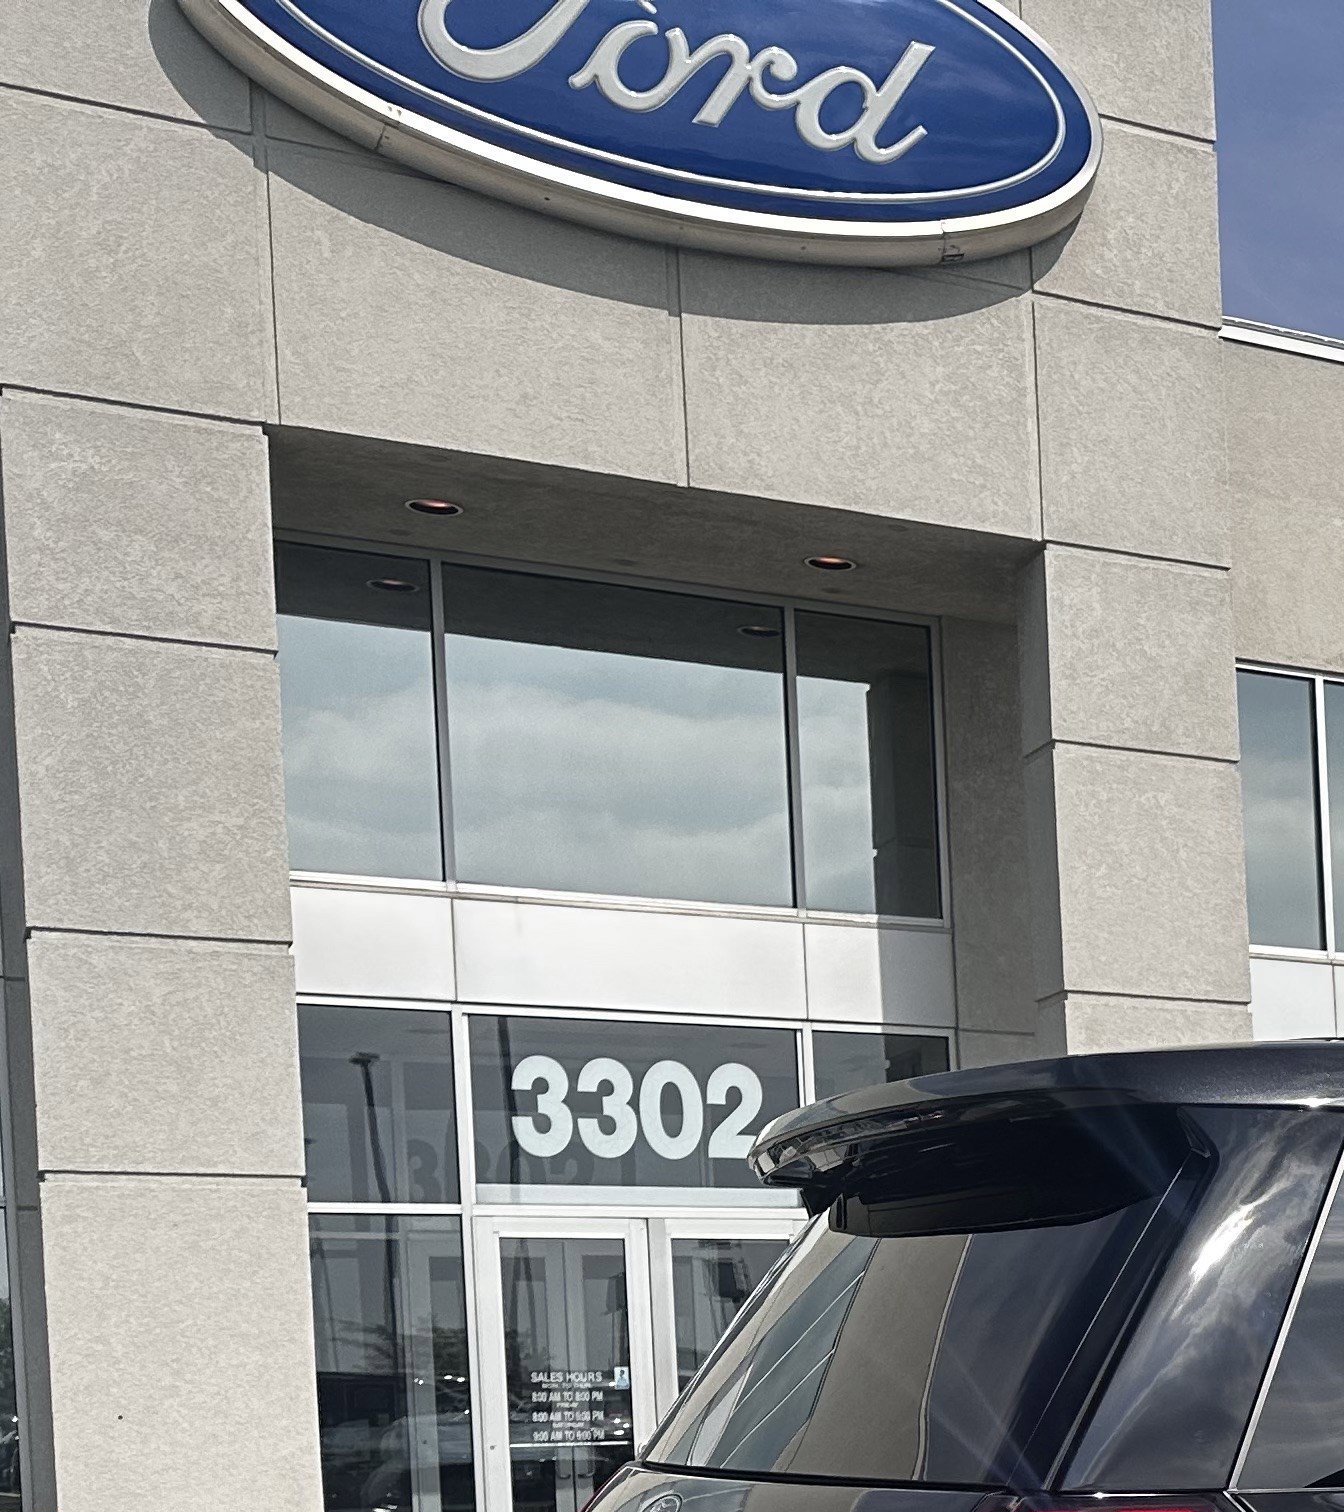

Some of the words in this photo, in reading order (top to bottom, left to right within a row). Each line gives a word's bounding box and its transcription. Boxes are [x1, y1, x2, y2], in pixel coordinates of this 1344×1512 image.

[511, 1055, 763, 1160] 3302
[531, 1371, 563, 1383] SALES
[566, 1371, 603, 1382] HOURS
